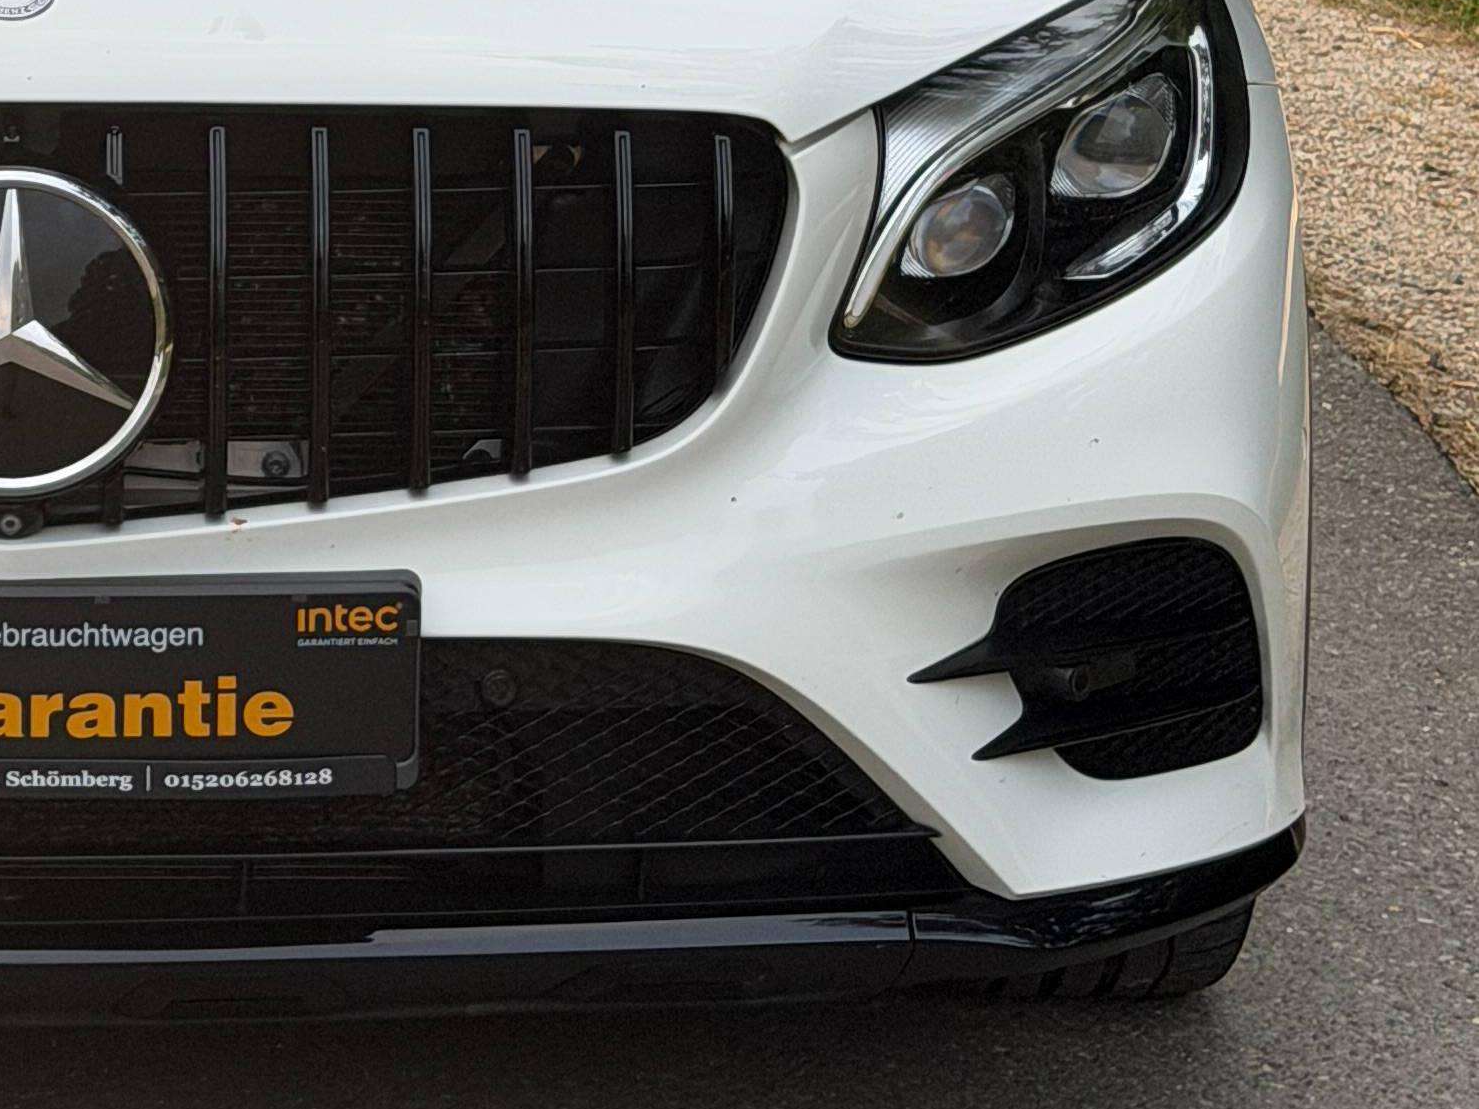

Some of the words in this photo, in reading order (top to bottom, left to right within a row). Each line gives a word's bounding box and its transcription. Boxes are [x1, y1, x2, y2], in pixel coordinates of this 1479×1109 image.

[297, 604, 399, 632] intec
[5, 769, 134, 791] Schömberg
[163, 767, 333, 791] 015206268128
